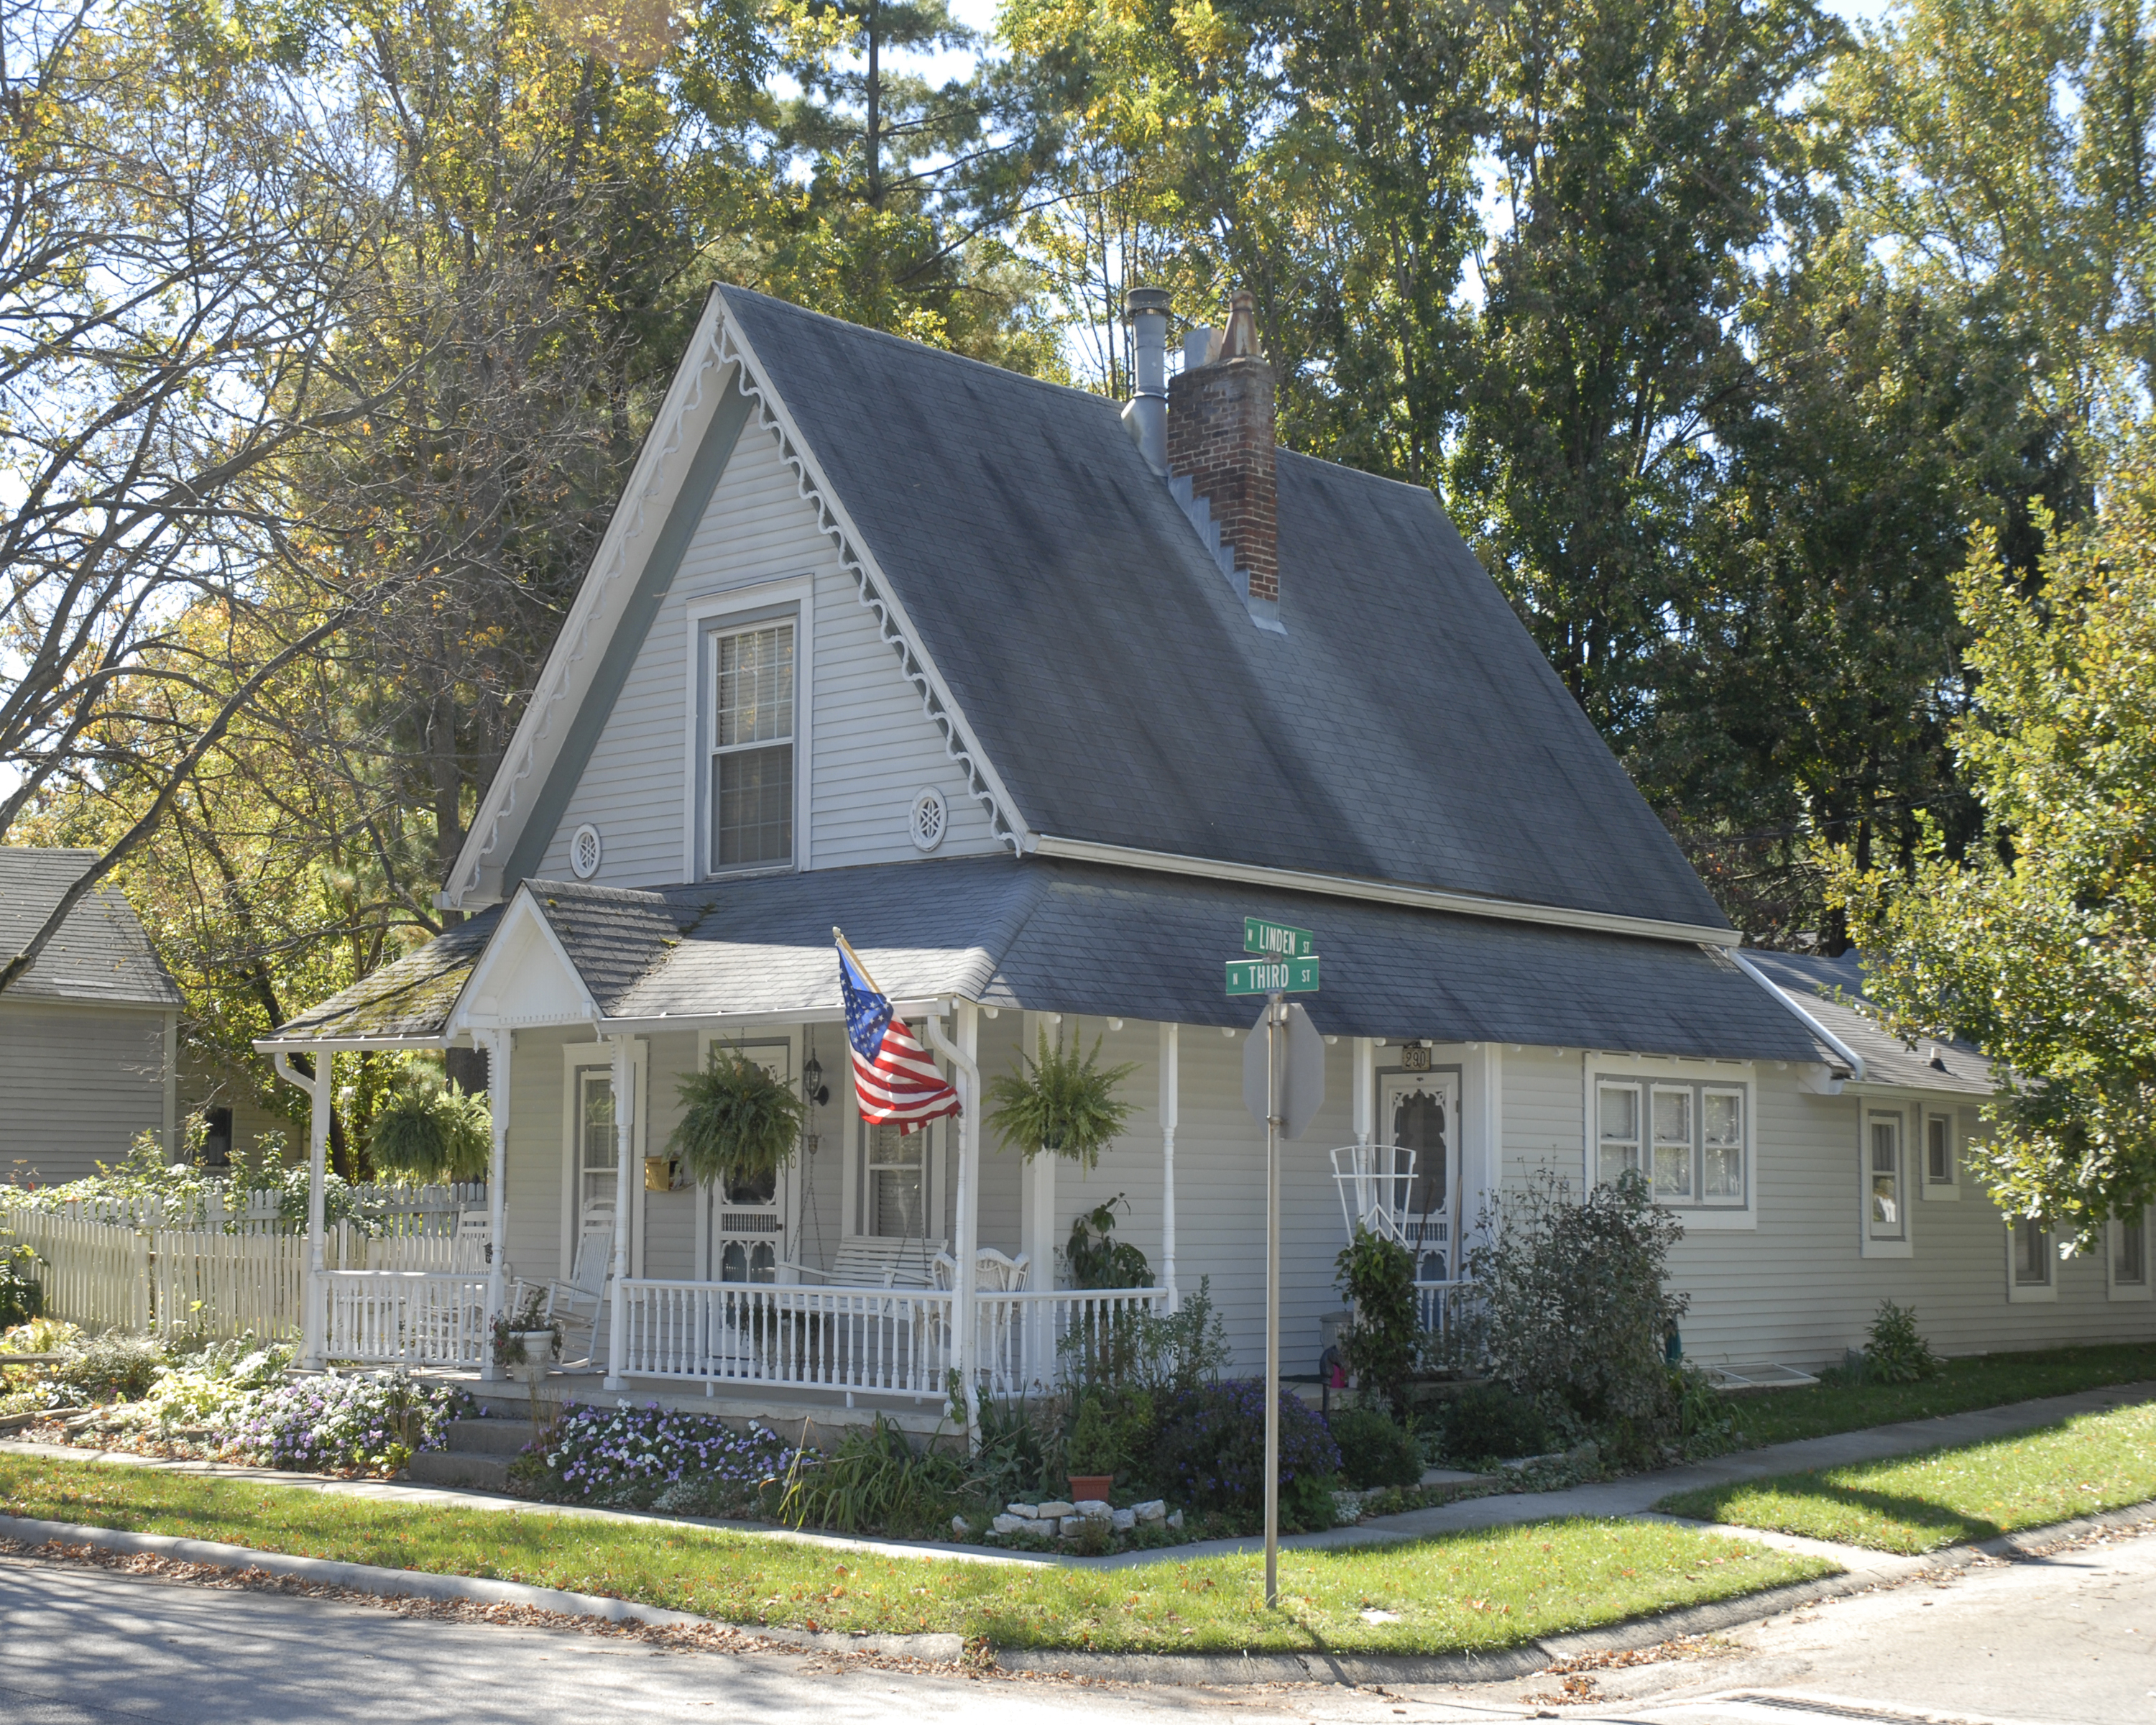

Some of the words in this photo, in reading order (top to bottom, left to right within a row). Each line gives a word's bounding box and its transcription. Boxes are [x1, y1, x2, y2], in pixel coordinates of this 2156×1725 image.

[1259, 924, 1296, 955] LINDEN
[1303, 941, 1309, 954] ST
[1233, 972, 1238, 985] N
[1248, 964, 1289, 989] THIRD
[1302, 970, 1310, 983] ST
[1406, 1051, 1426, 1067] 290
